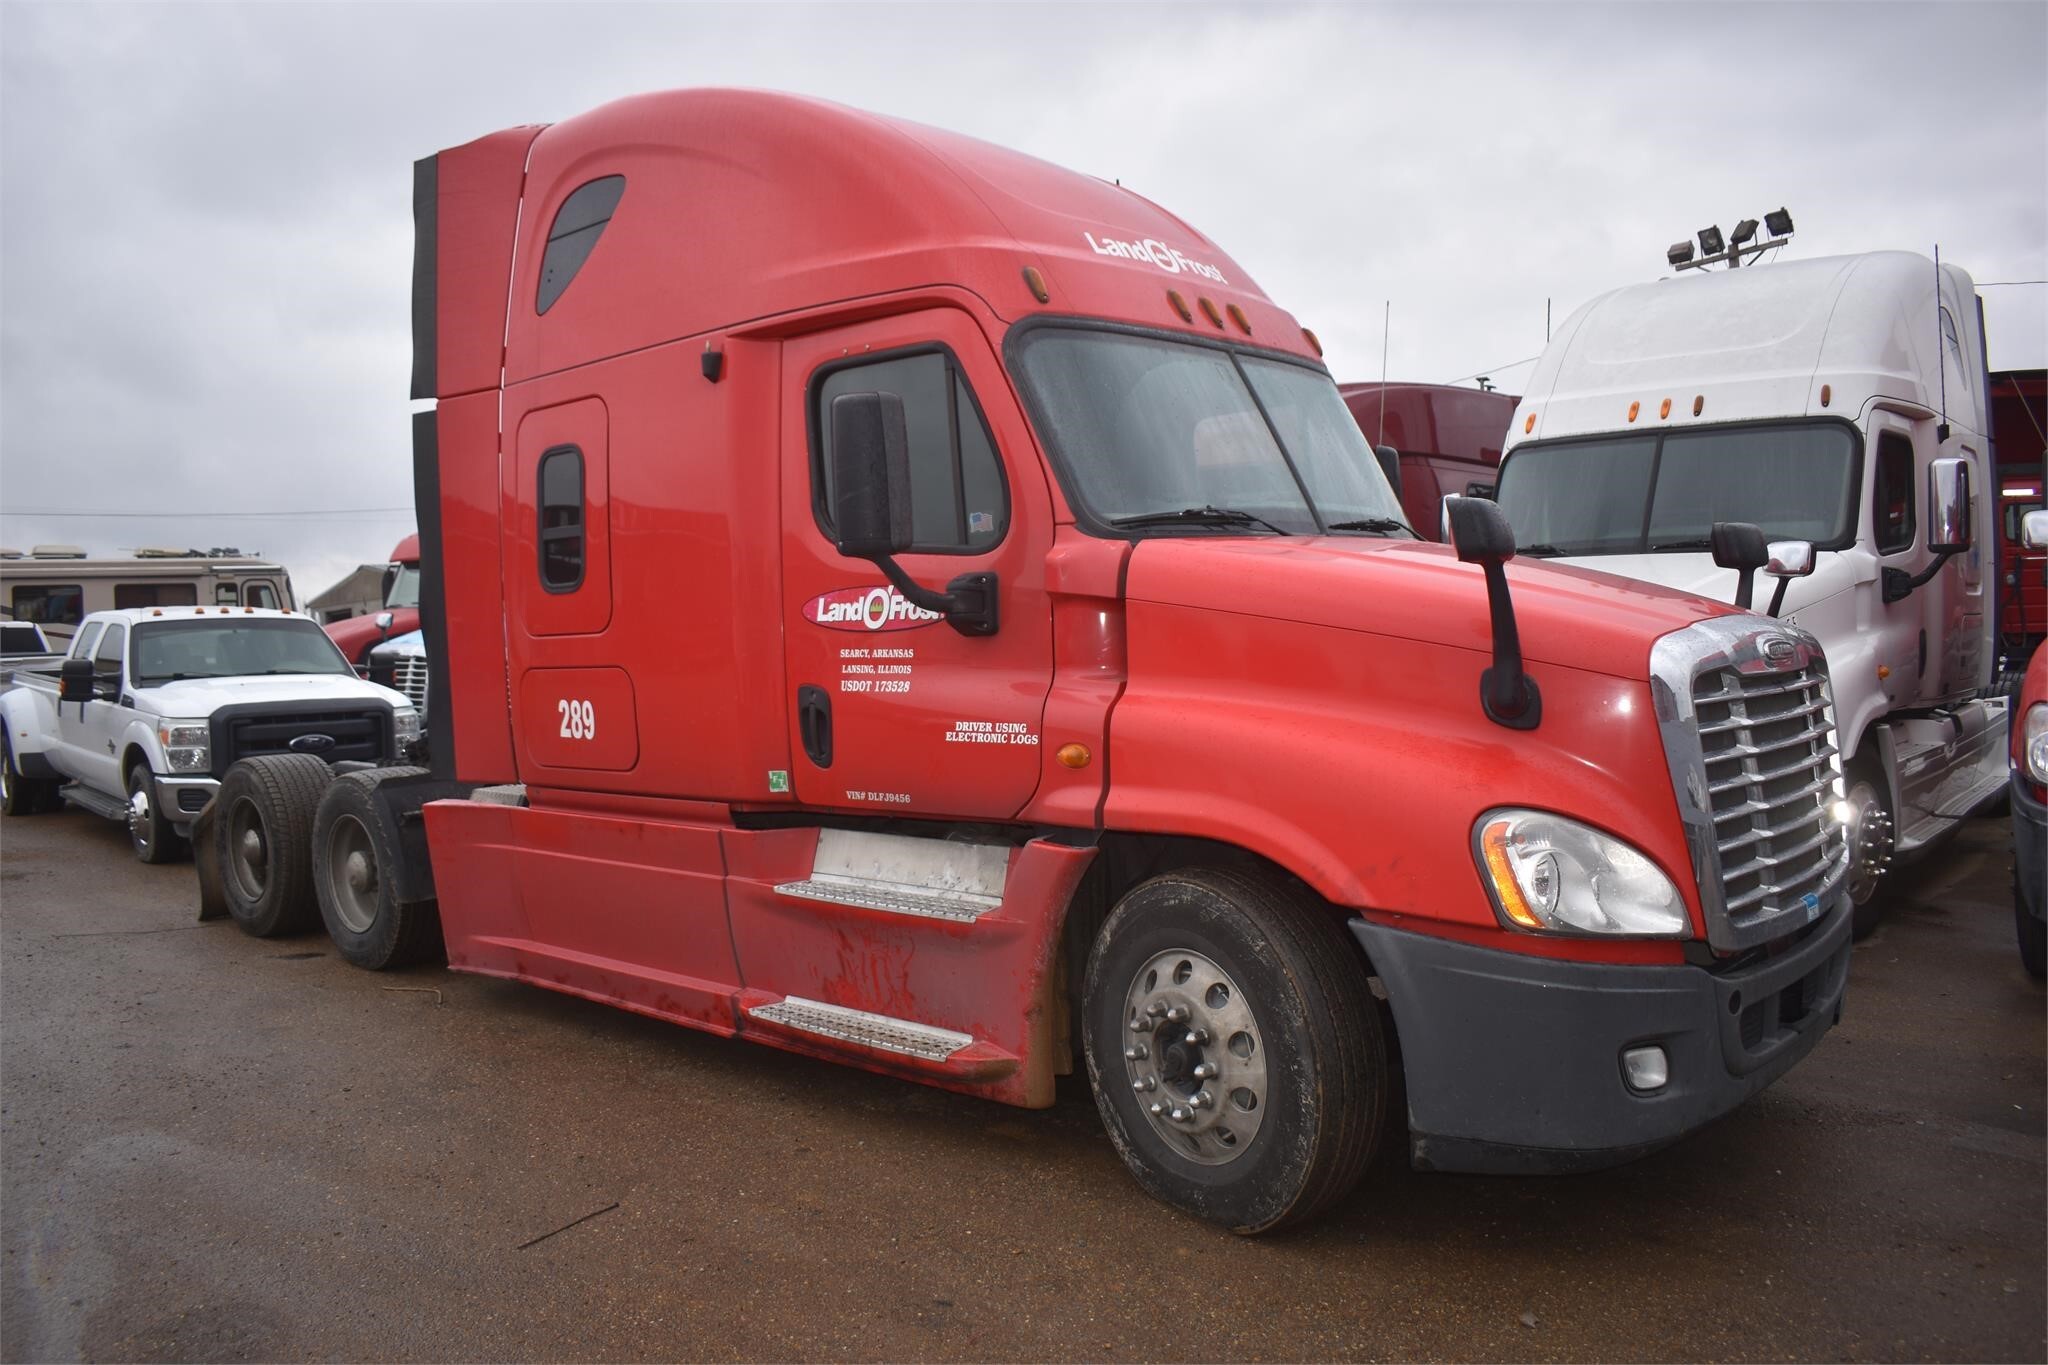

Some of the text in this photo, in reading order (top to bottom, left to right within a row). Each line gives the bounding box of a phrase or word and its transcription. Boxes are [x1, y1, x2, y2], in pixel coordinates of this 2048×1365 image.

[840, 648, 914, 659] SEARCY, ARKANSAS
[842, 665, 912, 675] LANSING, ILLINOIS
[841, 681, 911, 692] USDOT 173528
[558, 699, 595, 740] 289
[955, 721, 1027, 733] DRIVER USING
[945, 731, 1039, 745] ELECTRONIC LOGS
[846, 790, 866, 800] VIN#
